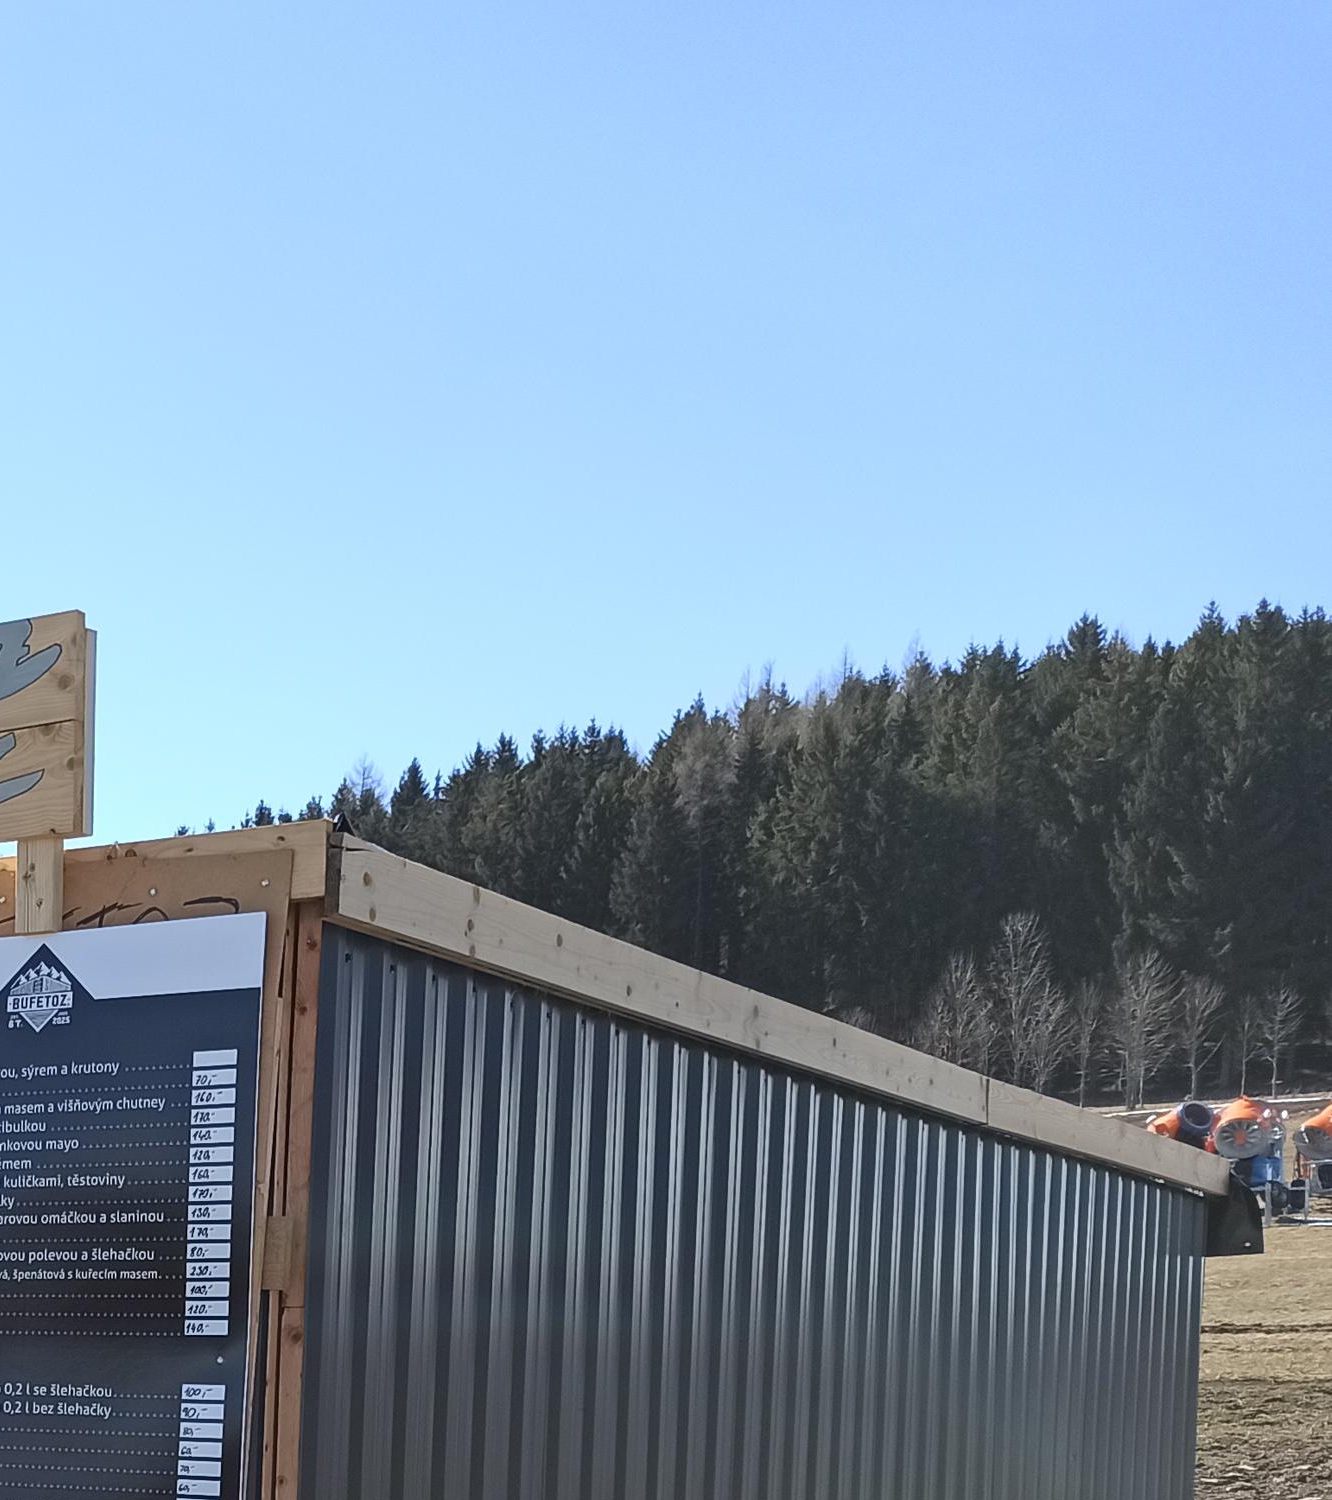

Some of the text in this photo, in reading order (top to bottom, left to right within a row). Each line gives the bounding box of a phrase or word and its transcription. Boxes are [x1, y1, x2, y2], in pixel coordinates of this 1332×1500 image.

[12, 994, 67, 1010] BUFETOZ
[21, 1064, 57, 1080] sýrem
[60, 1064, 68, 1074] a
[71, 1061, 119, 1075] krutony
[4, 1103, 44, 1114] masem
[47, 1102, 54, 1112] a
[57, 1098, 113, 1113] višňovým
[116, 1096, 165, 1111] chutney
[45, 1139, 79, 1152] mayo
[40, 1211, 96, 1224] omáčkou
[99, 1213, 106, 1223] a
[110, 1210, 164, 1223] slaninou
[3, 1382, 22, 1396] 0,2
[26, 1383, 30, 1395] l
[33, 1386, 47, 1396] se
[50, 1383, 112, 1397] šlehačkou
